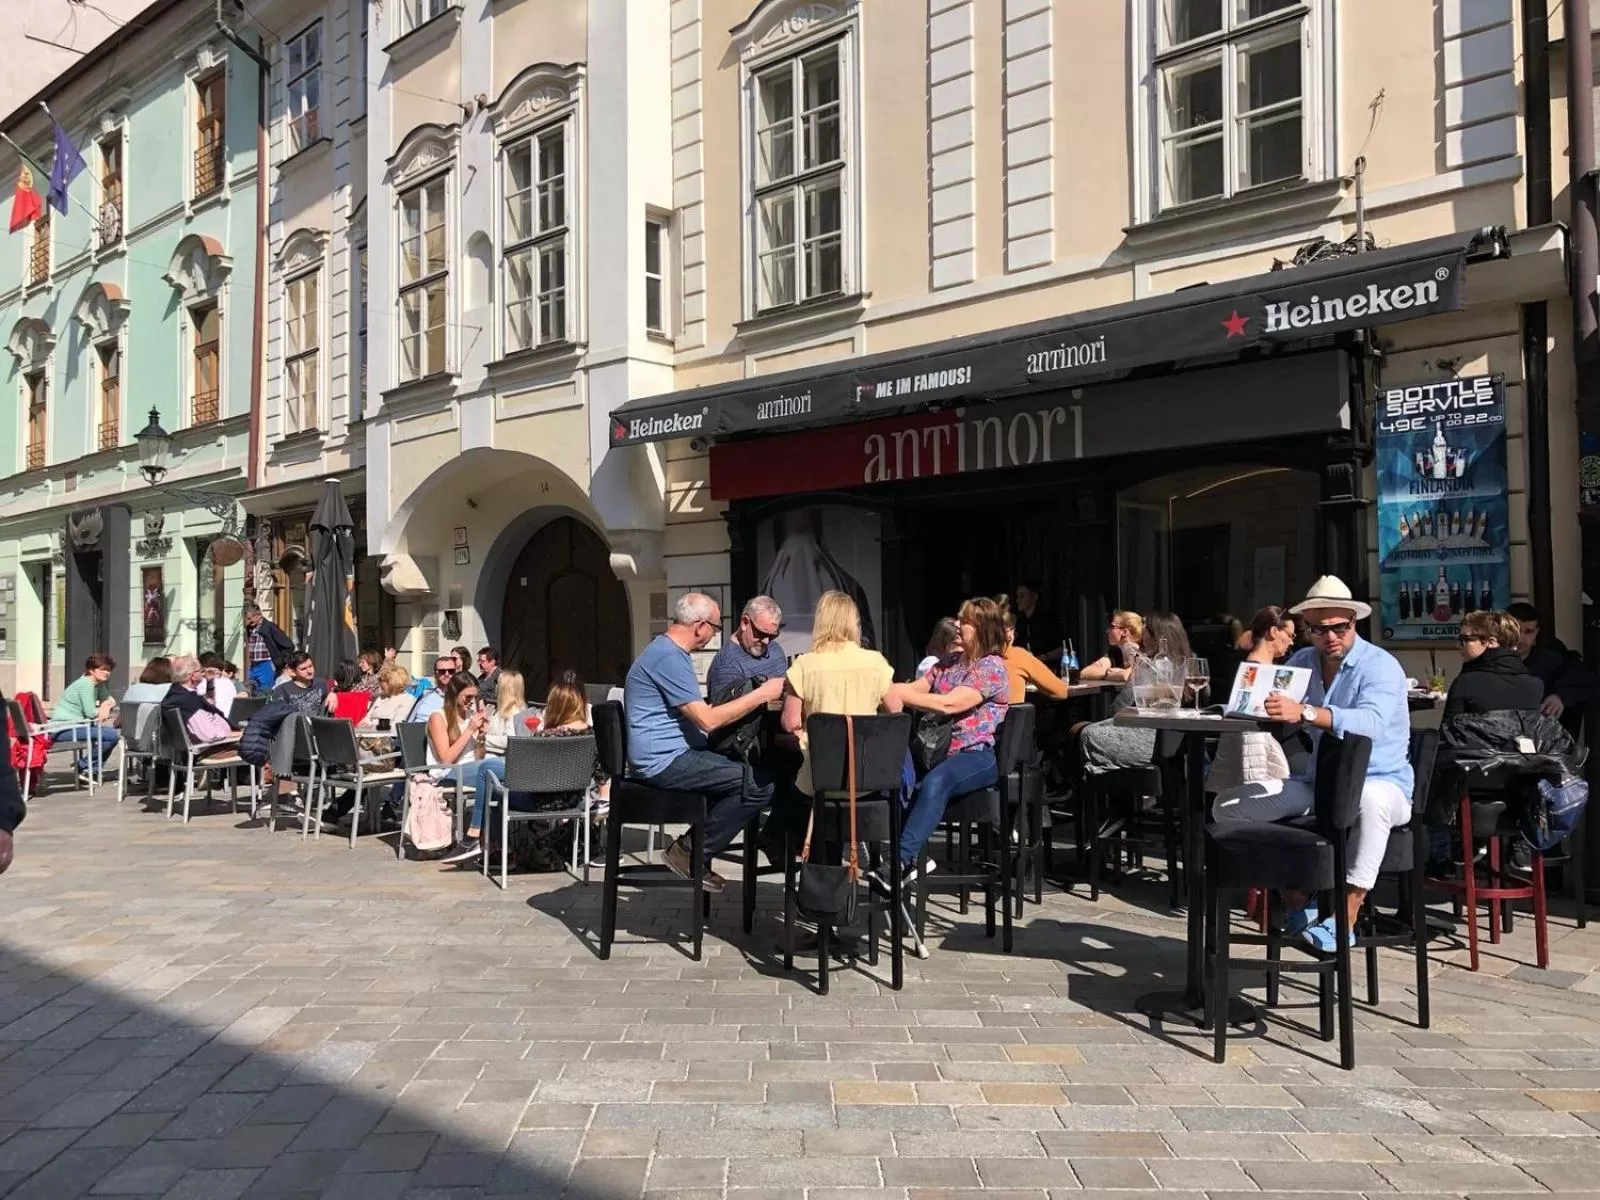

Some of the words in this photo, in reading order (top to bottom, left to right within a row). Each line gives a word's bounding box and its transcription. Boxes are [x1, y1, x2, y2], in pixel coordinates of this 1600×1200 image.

[875, 379, 893, 398] ME
[896, 376, 912, 396] IM
[914, 366, 971, 392] FAMOUS!
[1387, 377, 1493, 404] BOTTLE
[1387, 392, 1494, 417] SERVICE
[1409, 479, 1475, 495] FINLANDIA
[1422, 626, 1461, 636] BACARD
